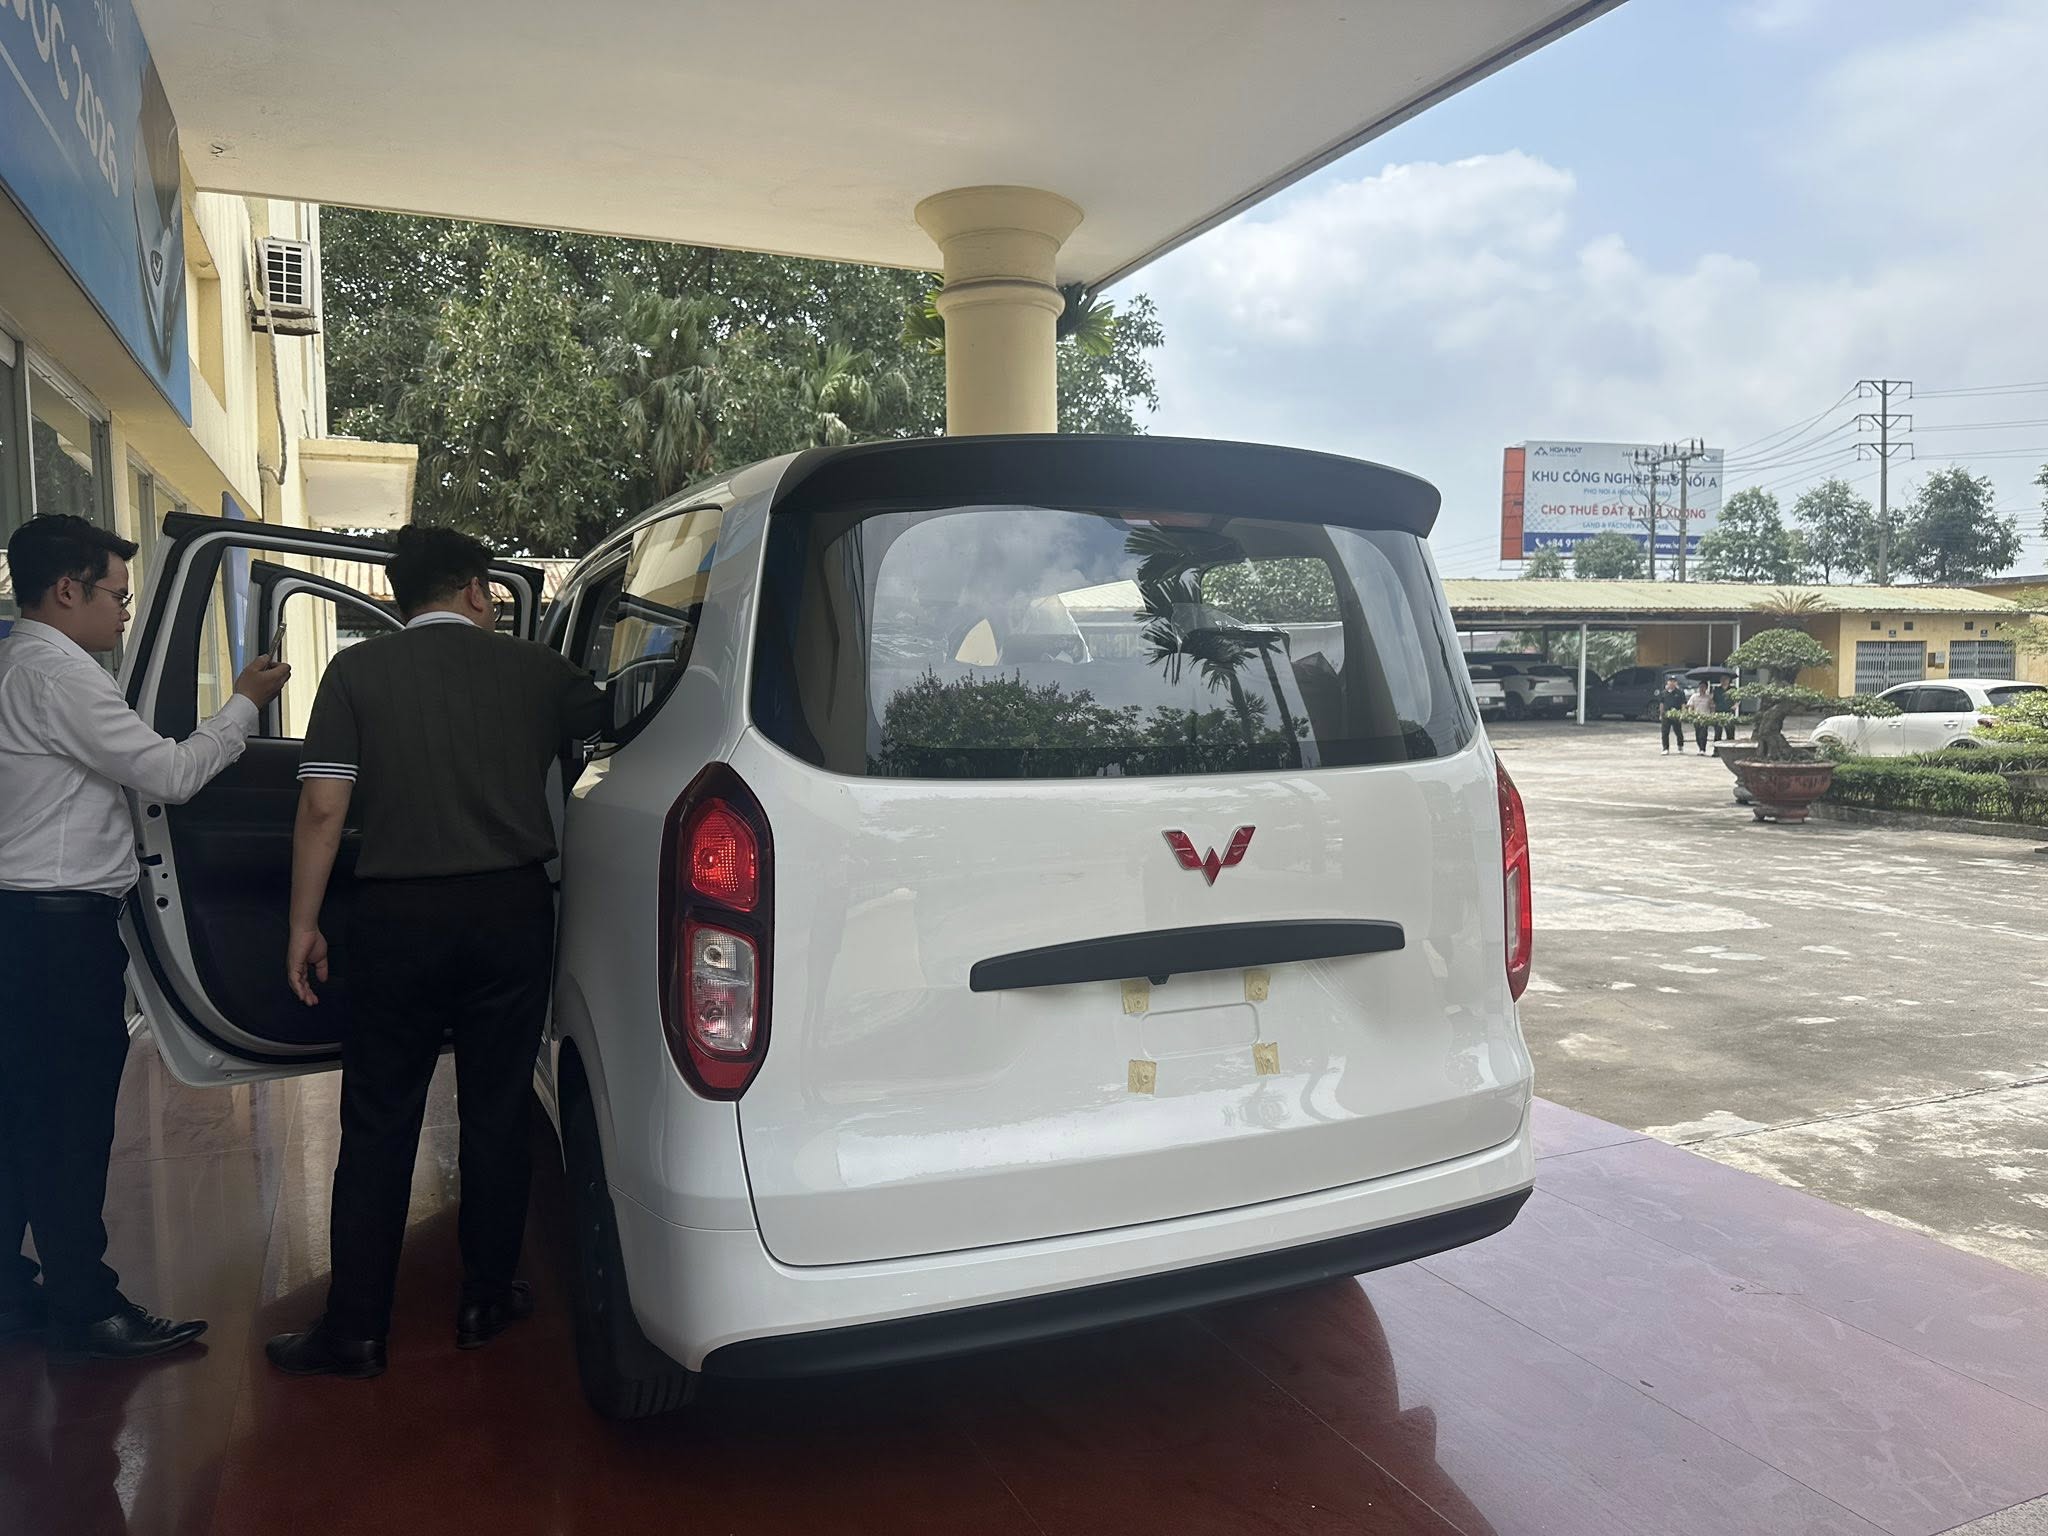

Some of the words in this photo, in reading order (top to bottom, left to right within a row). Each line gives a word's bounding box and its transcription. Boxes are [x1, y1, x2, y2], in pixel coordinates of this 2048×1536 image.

[70, 44, 119, 198] 2026
[1532, 470, 1558, 482] KHU
[1562, 468, 1600, 483] CÔNG
[1708, 476, 1718, 488] A
[1541, 504, 1566, 515] CHO
[1568, 503, 1598, 516] THUÊ
[1602, 502, 1624, 516] ĐẤT
